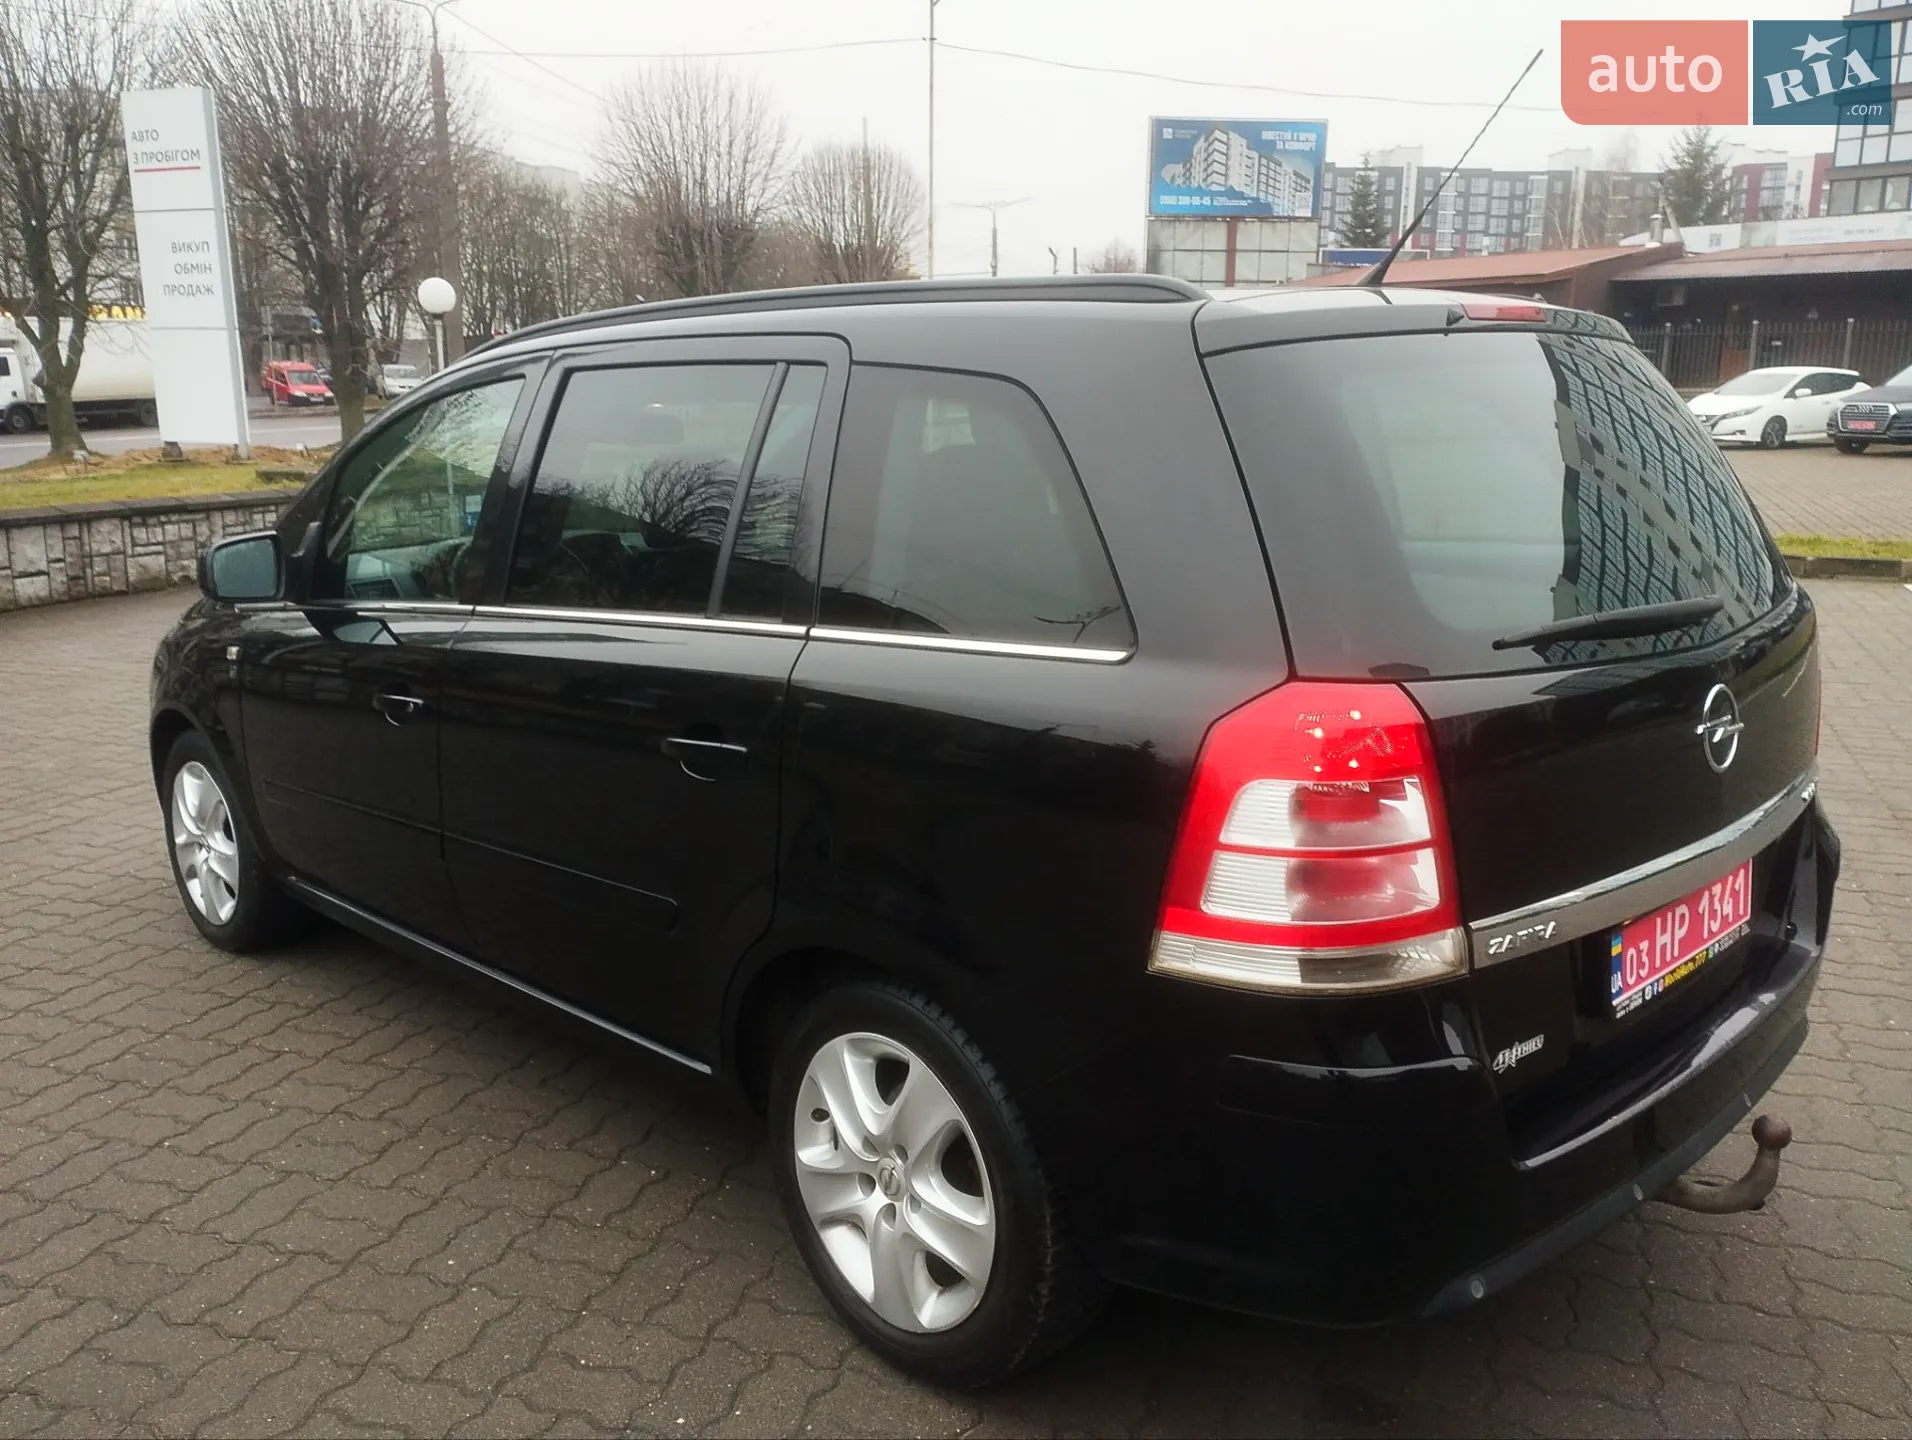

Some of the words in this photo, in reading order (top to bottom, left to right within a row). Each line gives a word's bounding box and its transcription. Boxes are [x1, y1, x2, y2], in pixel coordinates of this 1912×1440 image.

[131, 129, 159, 142] АВТО
[141, 149, 200, 164] ПРОБІГОМ
[171, 241, 210, 253] ВИКУП
[174, 263, 212, 275] ОБМІН
[163, 284, 214, 297] ПРОДАЖ
[1626, 940, 1650, 985] 03
[1655, 904, 1690, 968] HP
[1698, 868, 1745, 940] 1341
[1611, 971, 1623, 994] UA
